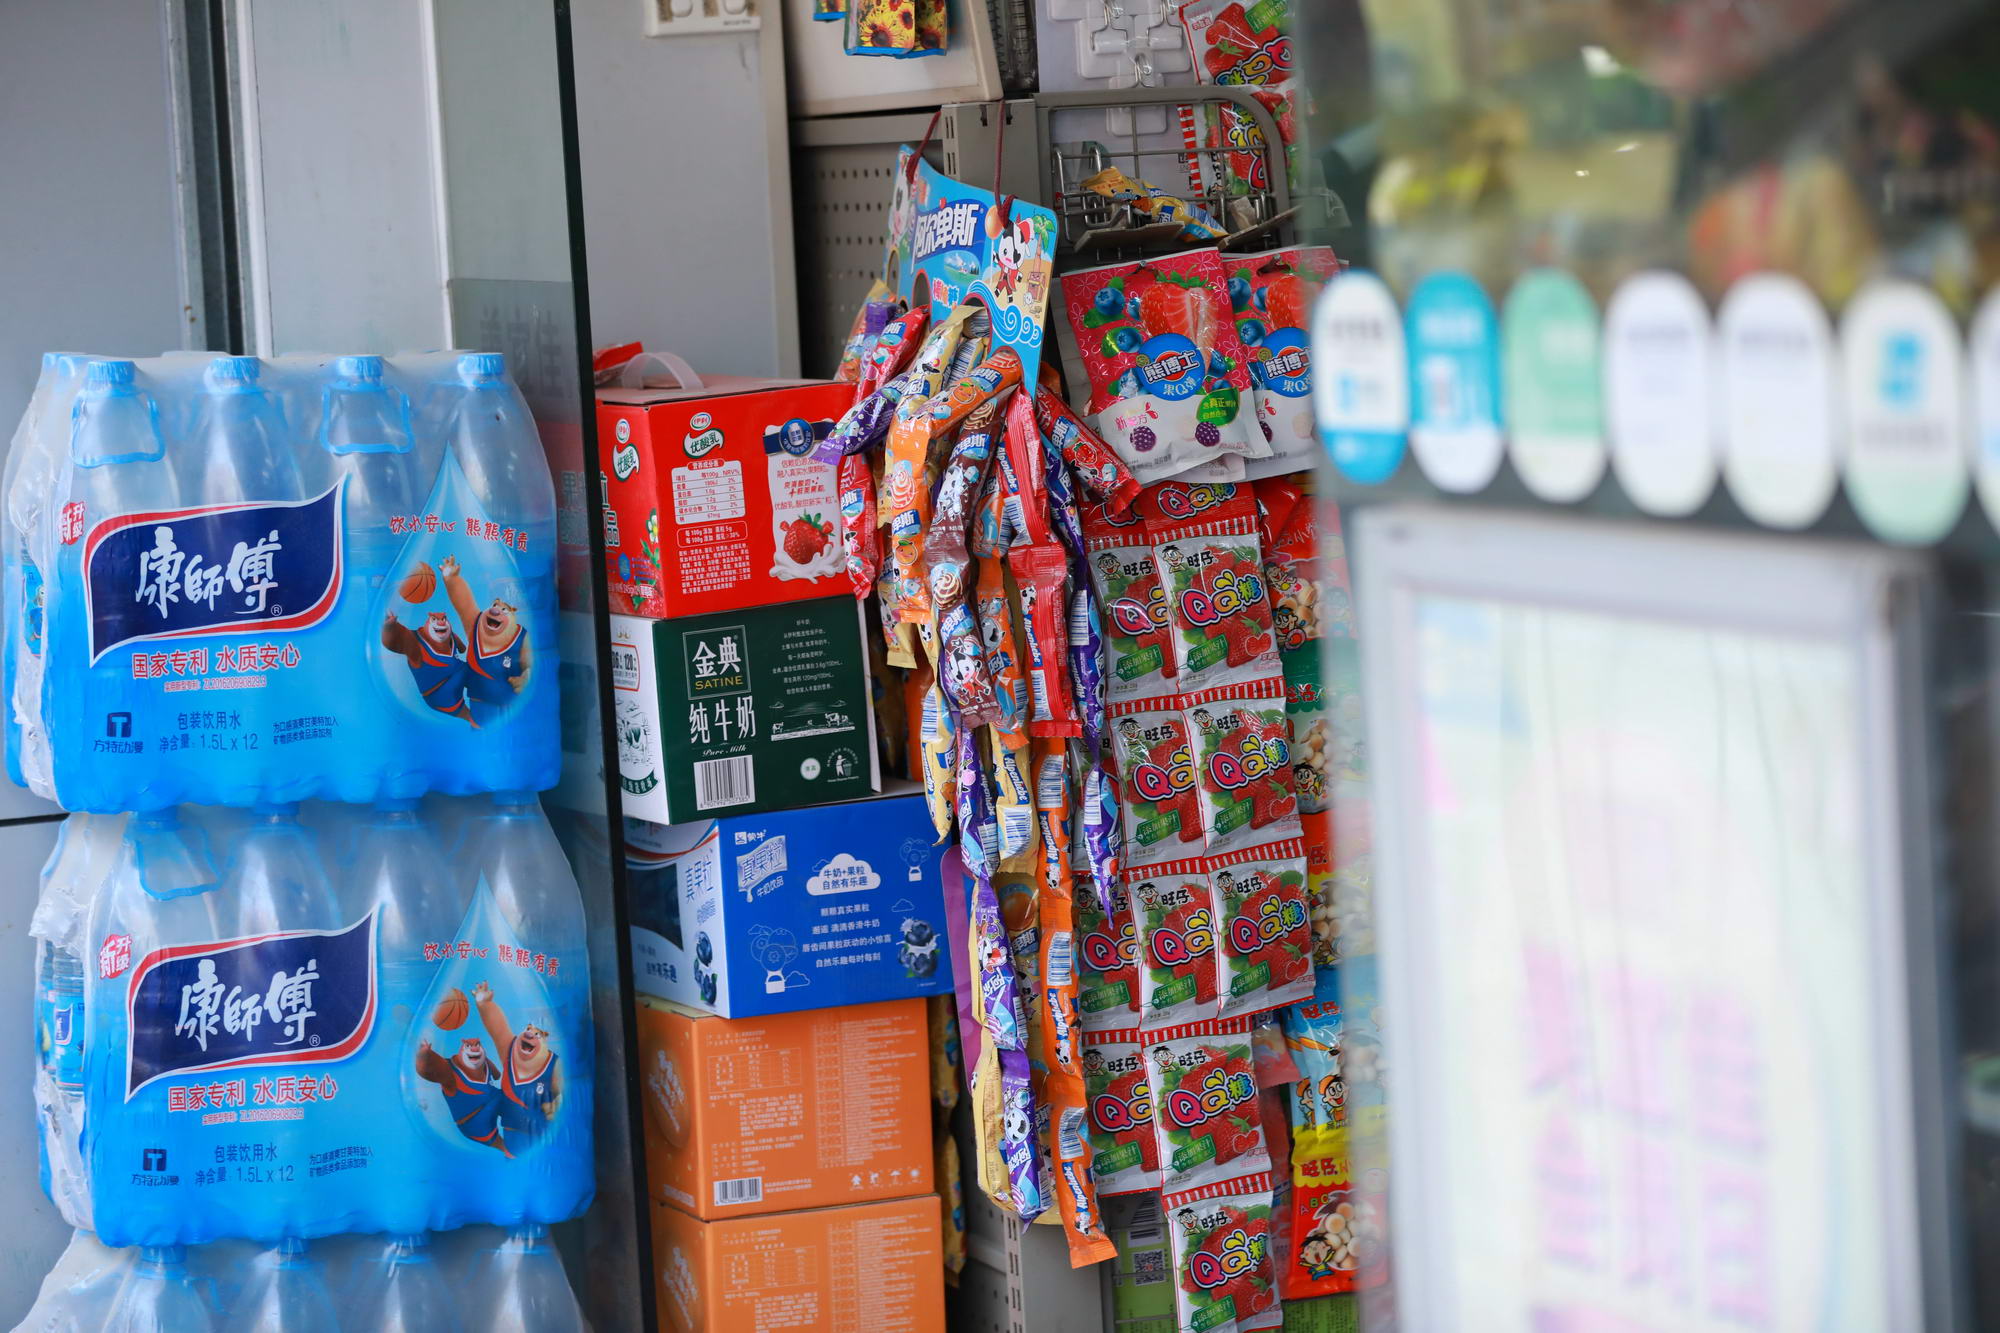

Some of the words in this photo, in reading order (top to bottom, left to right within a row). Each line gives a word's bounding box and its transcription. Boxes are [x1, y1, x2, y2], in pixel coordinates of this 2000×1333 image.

[911, 204, 979, 275] 阿尔卑斯
[1143, 350, 1200, 383] 熊博士
[1163, 376, 1197, 396] 果Q弹
[690, 431, 720, 454] 优酸乳
[617, 449, 636, 475] 优酸乳
[389, 513, 456, 535] 饮水安心
[465, 516, 529, 552] 熊熊有责
[1123, 560, 1153, 576] 旺仔
[1187, 551, 1214, 568] 旺仔
[136, 526, 282, 619] 康師傅
[1180, 573, 1264, 627] QQ糖
[132, 648, 208, 680] 国家专利
[214, 643, 301, 678] 水质安心
[692, 636, 741, 678] 金典
[695, 675, 744, 690] SATINE
[177, 711, 242, 731] 包装饮用水
[688, 695, 757, 744] 纯牛奶
[1216, 714, 1241, 730] 旺仔
[201, 733, 228, 752] 1.5L
[243, 732, 260, 751] 12
[1144, 725, 1175, 741] 旺仔
[702, 749, 724, 757] Pure
[1208, 737, 1290, 789] QQ糖
[1004, 757, 1027, 801] Alpenliebe
[747, 832, 764, 842] 蒙牛
[742, 842, 784, 885] 真果粒
[823, 865, 865, 879] 牛奶+果粒
[756, 876, 785, 897] 牛奶饮品
[822, 875, 868, 891] 自然有乐趣
[1236, 876, 1262, 894] 旺仔
[1161, 888, 1190, 906] 旺仔
[1229, 901, 1305, 955] QQ糖
[424, 940, 489, 961] 饮水安心
[498, 943, 562, 976] 熊熊有责
[175, 958, 320, 1052] 康師傅
[1107, 1056, 1139, 1072] 旺仔
[1178, 1050, 1208, 1067] 旺仔
[168, 1078, 246, 1112] 国家专利
[253, 1073, 339, 1106] 水质安心
[1167, 1072, 1256, 1127] QQ糖
[214, 1142, 278, 1164] 包装饮用水
[236, 1166, 263, 1183] 1.5L
[278, 1165, 294, 1182] 12
[1301, 1158, 1338, 1177] 旺仔
[1065, 1167, 1088, 1209] Alpenliebe
[1200, 1211, 1229, 1230] 旺仔
